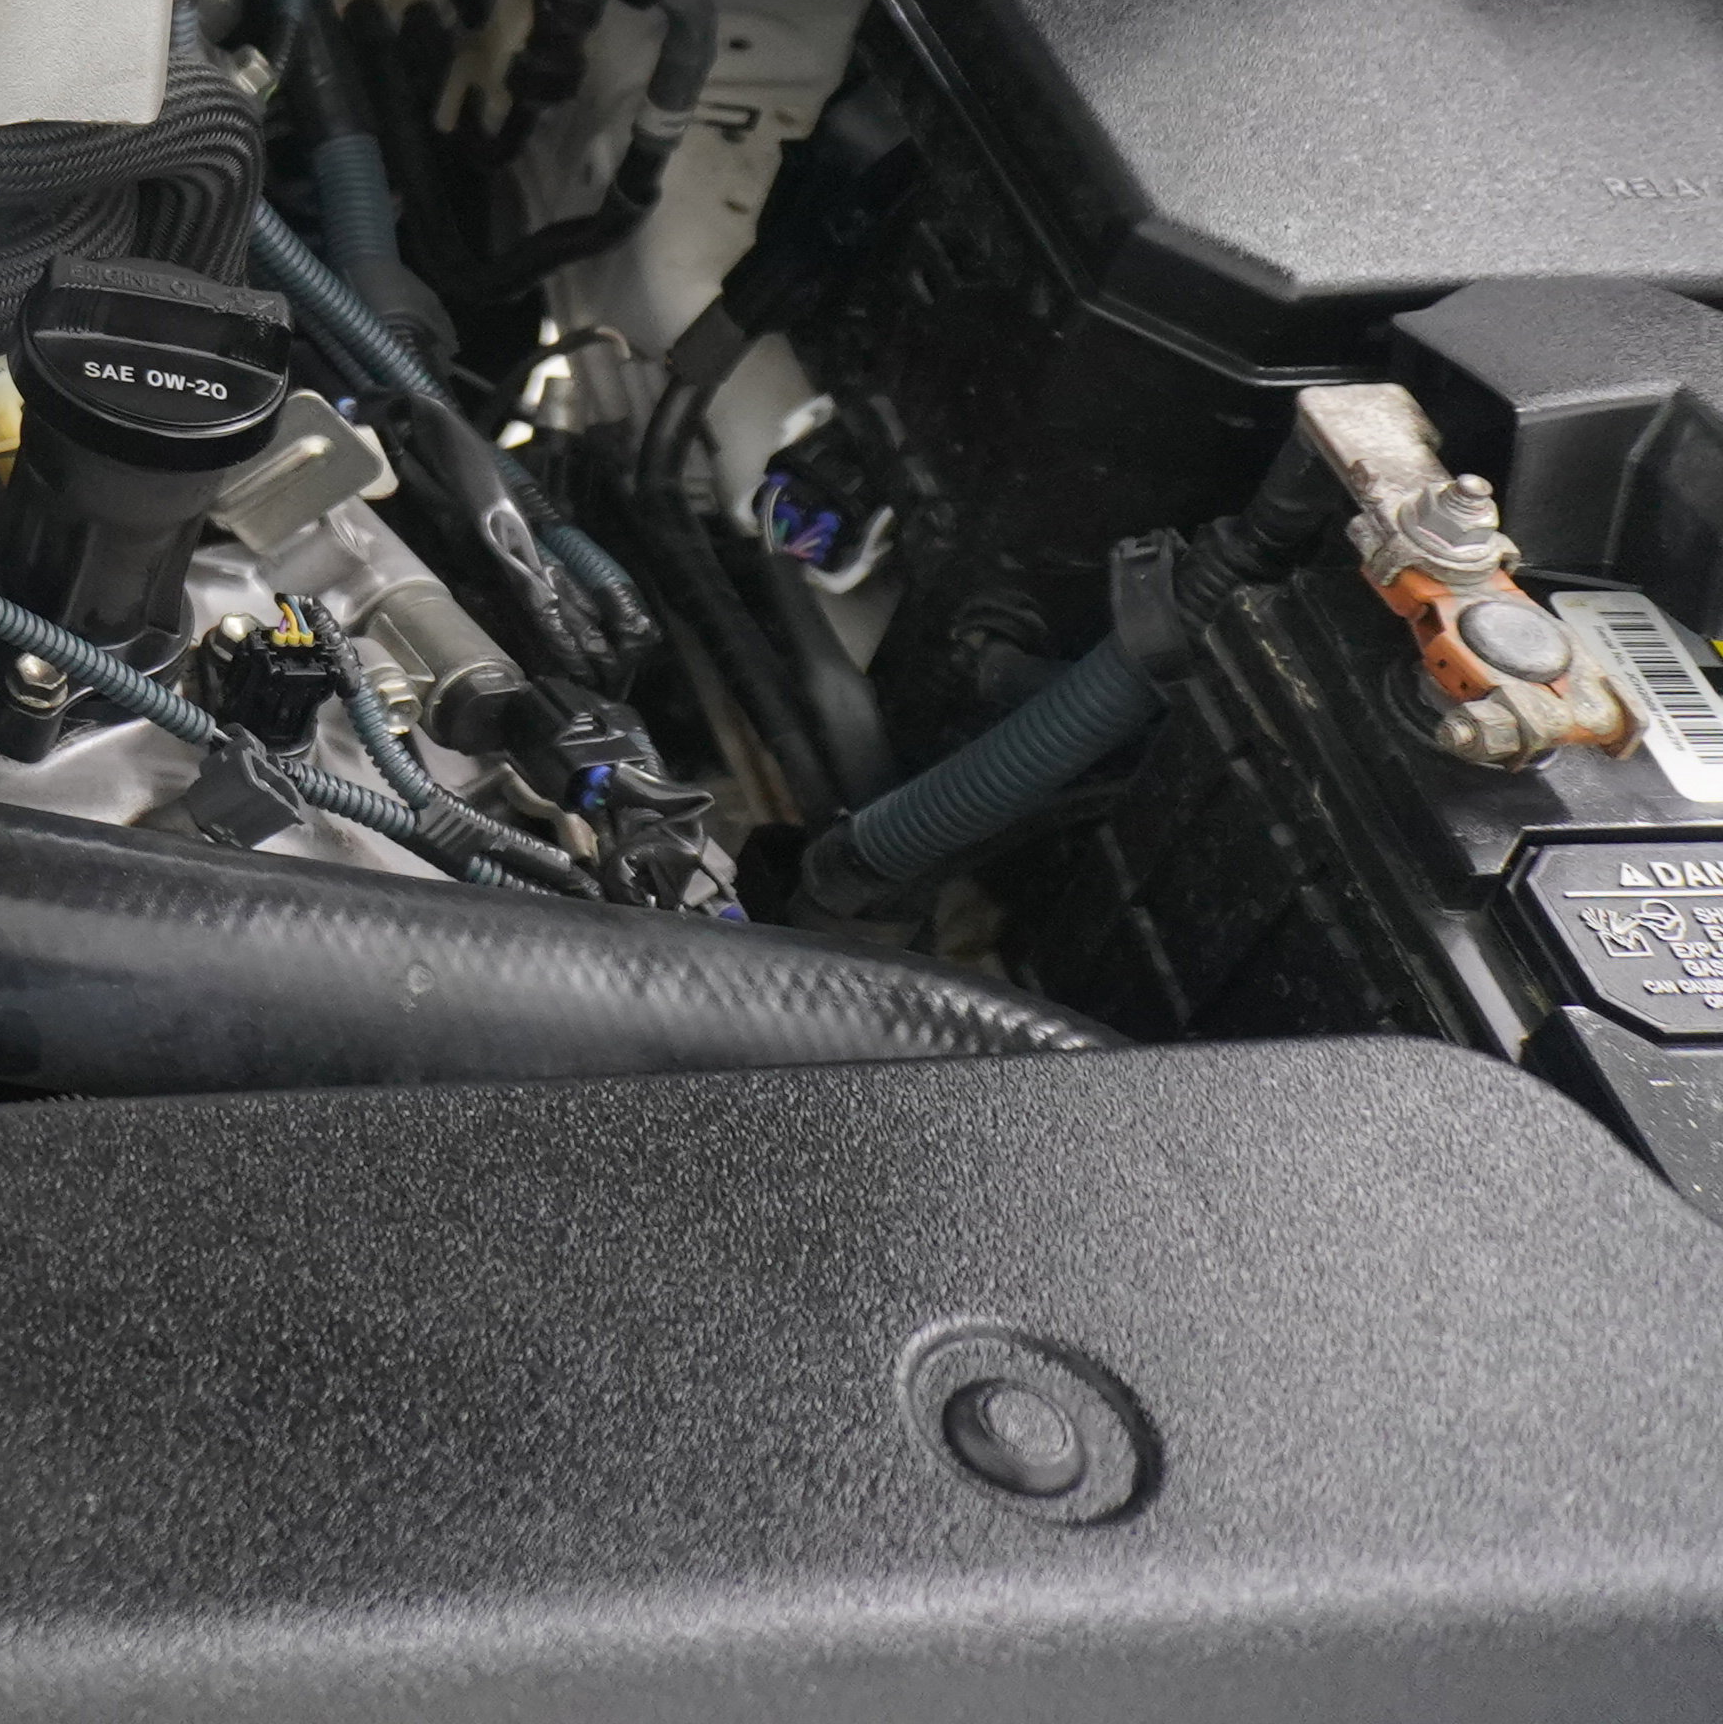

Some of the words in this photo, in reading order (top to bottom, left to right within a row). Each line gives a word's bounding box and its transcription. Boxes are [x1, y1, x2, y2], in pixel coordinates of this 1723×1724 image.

[1600, 177, 1720, 198] RELA
[84, 361, 135, 383] SAE
[146, 370, 228, 400] 0W-20
[1669, 942, 1723, 959] EXPL
